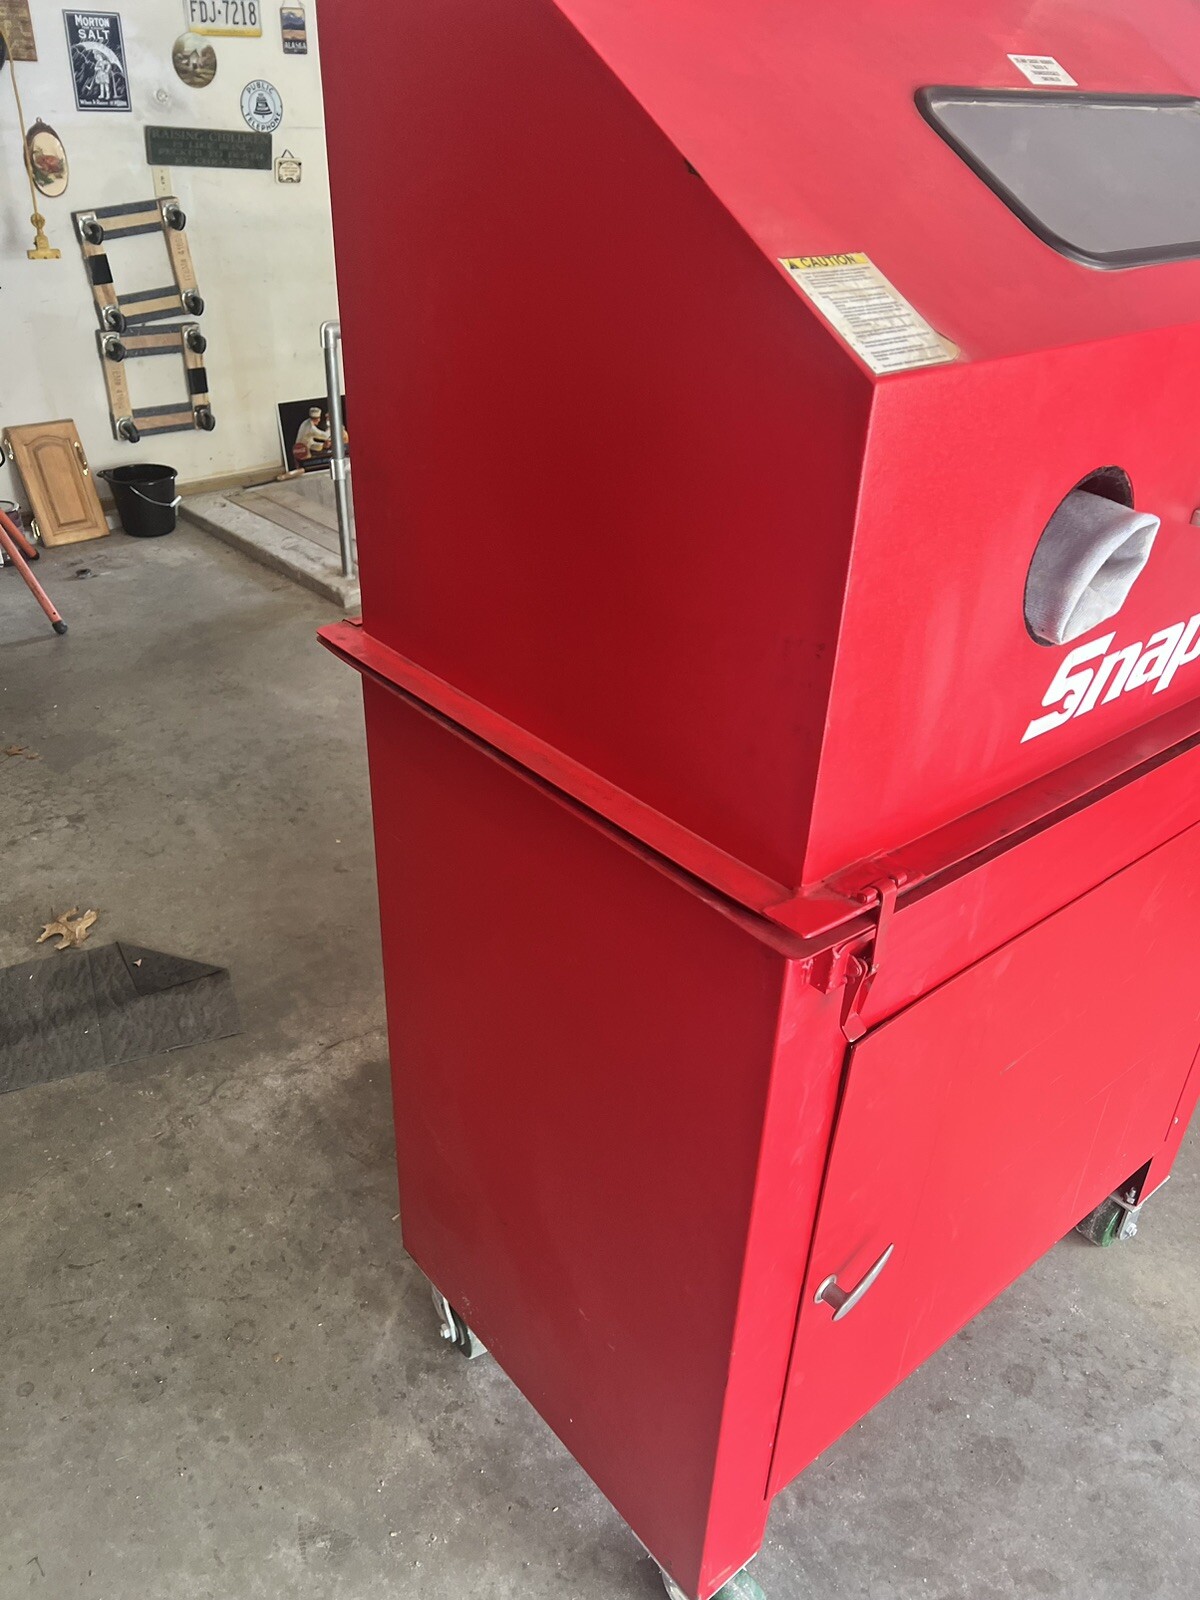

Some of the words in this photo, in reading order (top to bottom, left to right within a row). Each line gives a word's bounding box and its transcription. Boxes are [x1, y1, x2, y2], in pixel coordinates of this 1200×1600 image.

[74, 14, 110, 27] MORTON
[78, 29, 110, 40] SALT
[246, 81, 274, 94] PUBLIC
[245, 113, 281, 131] TELEPHONE
[152, 129, 204, 140] RAISING
[800, 254, 856, 268] CAUTION
